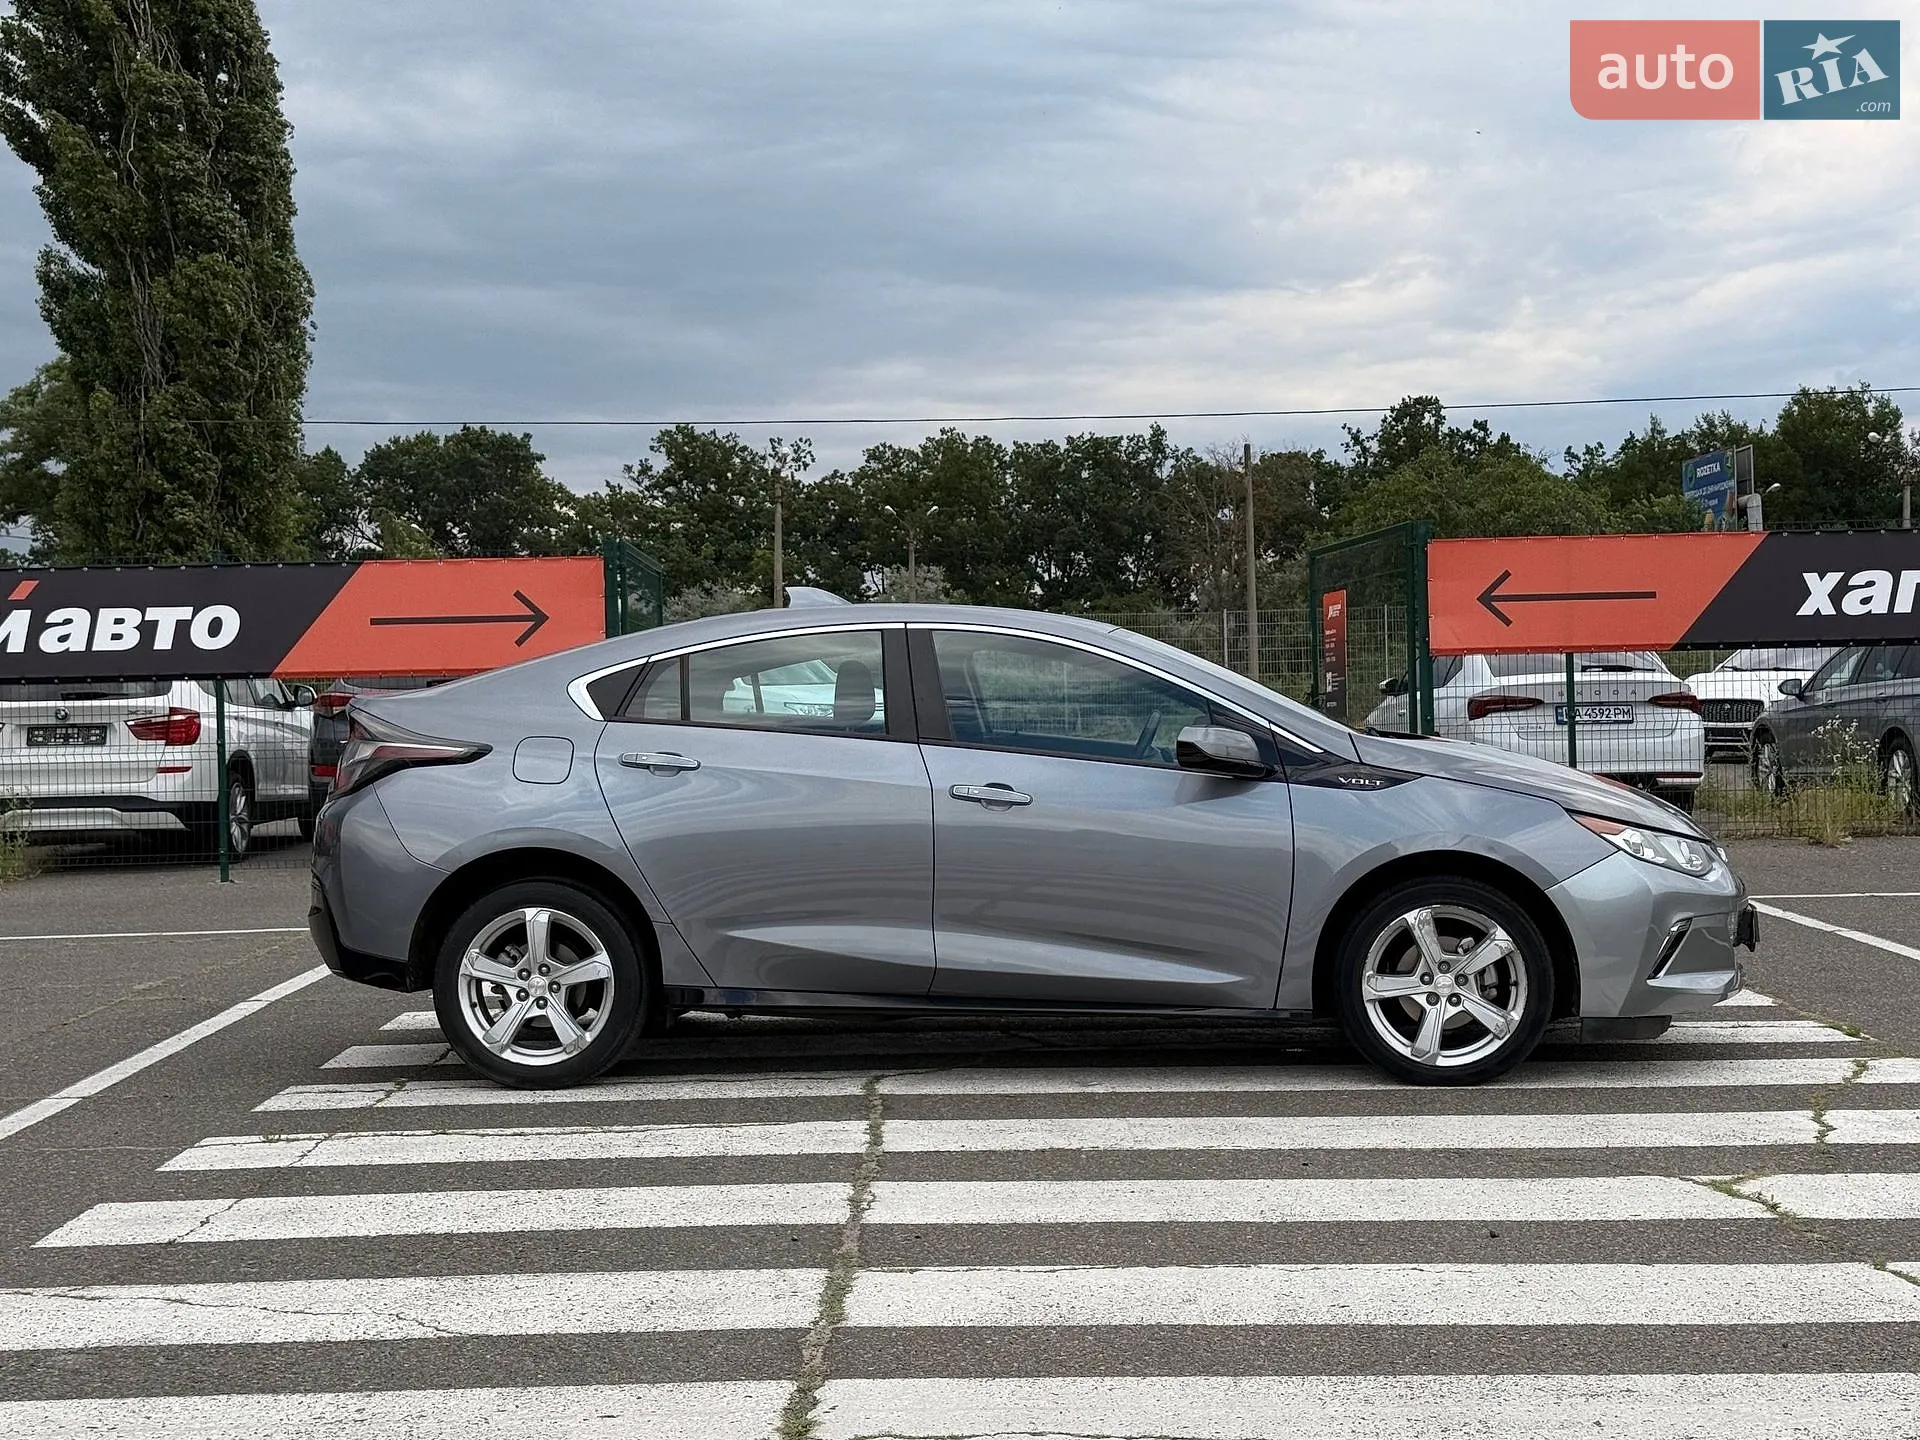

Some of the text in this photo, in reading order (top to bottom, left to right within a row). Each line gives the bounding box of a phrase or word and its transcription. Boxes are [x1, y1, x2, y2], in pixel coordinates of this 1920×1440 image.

[1696, 461, 1721, 478] ROZETKA
[1584, 707, 1611, 719] 4592
[1613, 706, 1632, 718] PM
[1338, 776, 1385, 787] VOLT
